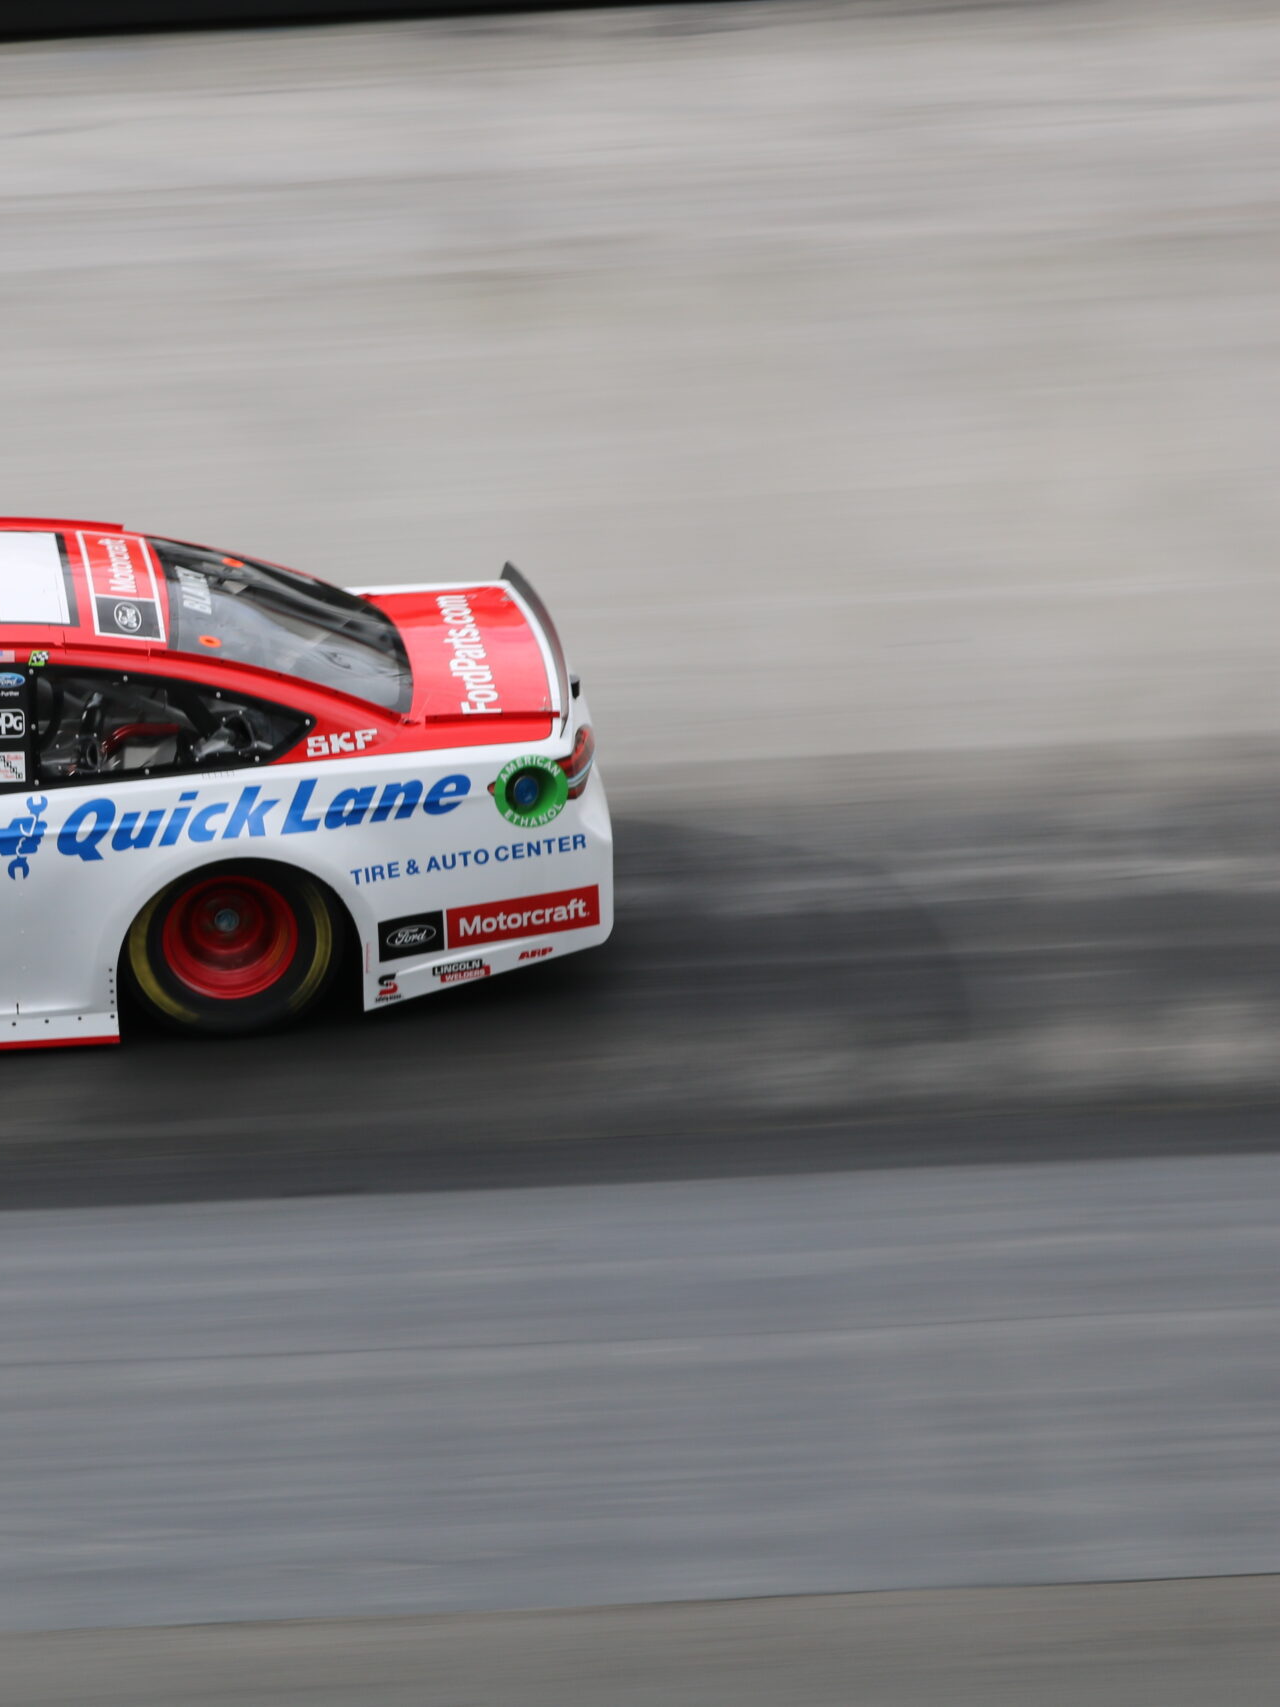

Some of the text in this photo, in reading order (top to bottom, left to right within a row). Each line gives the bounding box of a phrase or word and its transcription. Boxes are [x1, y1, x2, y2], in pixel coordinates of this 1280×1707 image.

[435, 594, 503, 715] FordParts.com
[306, 728, 379, 759] SKF
[500, 754, 561, 783] AMERICAN
[56, 773, 472, 862] Quick Lane
[504, 803, 563, 828] ETHANOL
[349, 832, 588, 886] TIRE & AUTO CENTER
[458, 897, 588, 938] Motorcraft
[394, 927, 428, 946] Ford
[434, 959, 481, 976] LINCOLN
[444, 967, 486, 983] WELDERS
